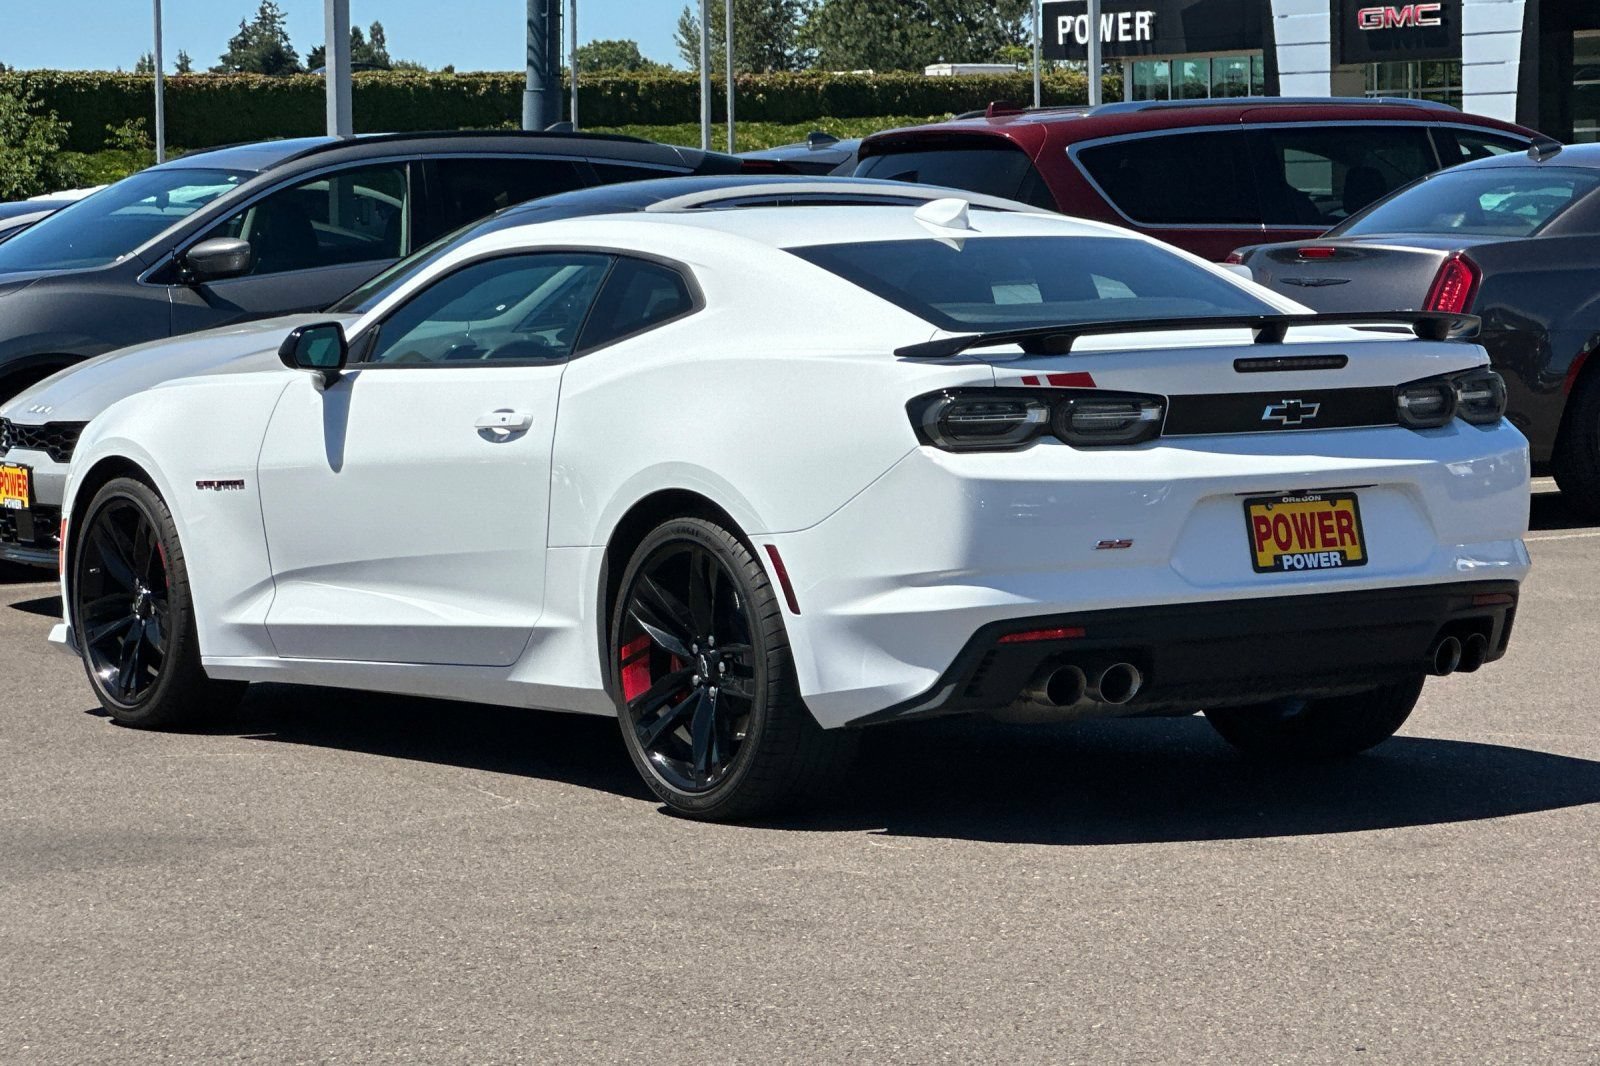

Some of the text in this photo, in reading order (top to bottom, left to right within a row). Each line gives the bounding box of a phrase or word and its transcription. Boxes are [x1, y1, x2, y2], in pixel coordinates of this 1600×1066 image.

[1058, 11, 1153, 45] POWER
[1358, 3, 1441, 30] GMC
[1282, 495, 1321, 503] OREGON
[1253, 509, 1357, 552] POWER
[1282, 551, 1342, 570] POWER
